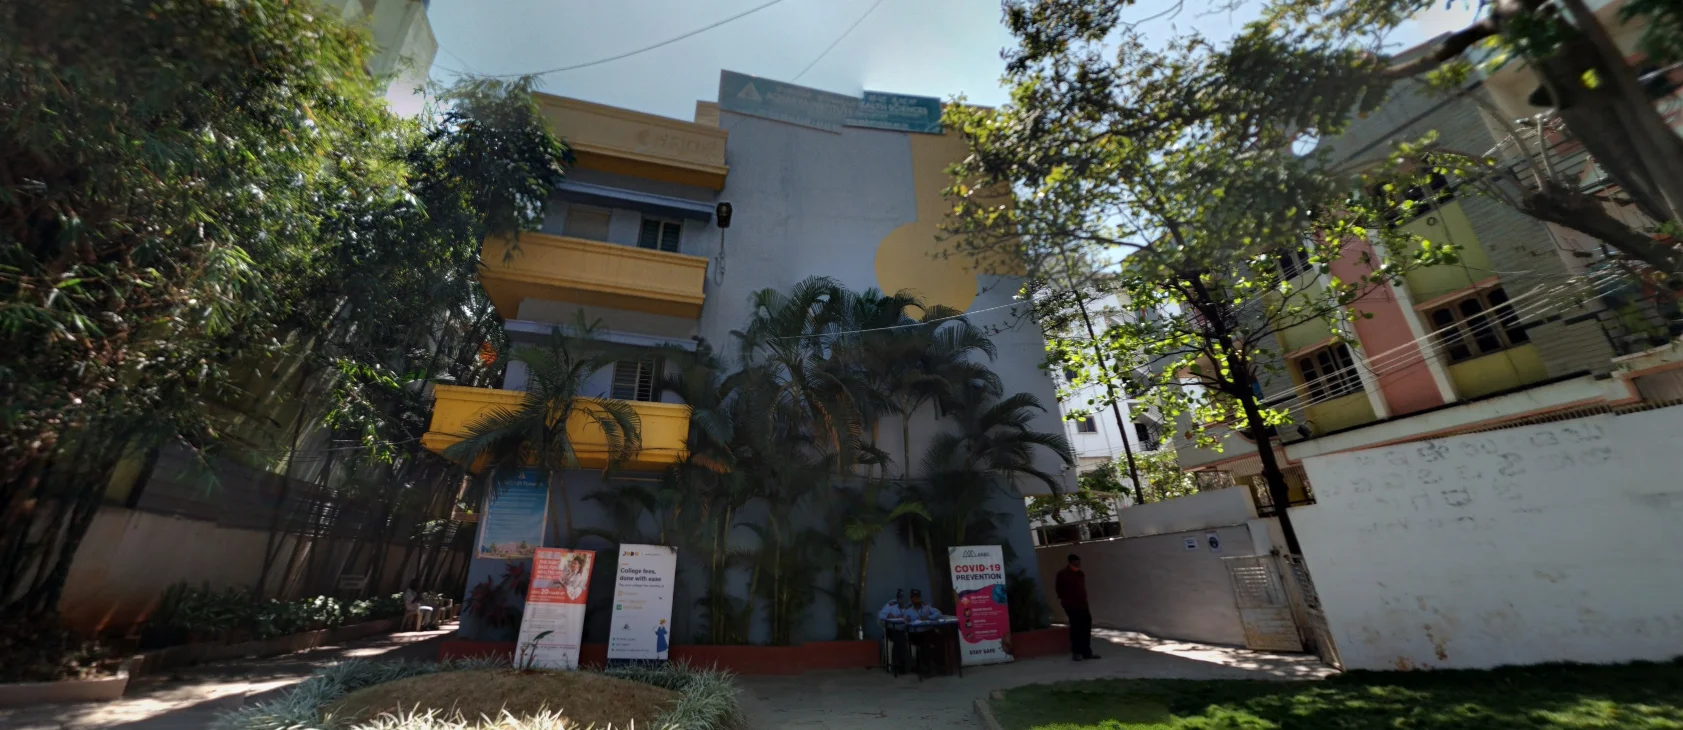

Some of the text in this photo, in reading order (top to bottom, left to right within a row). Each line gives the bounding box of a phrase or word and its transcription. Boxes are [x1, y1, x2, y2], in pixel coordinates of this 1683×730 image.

[620, 567, 642, 575] College
[955, 563, 1001, 573] COVID-19
[956, 573, 1002, 581] PREVENTION
